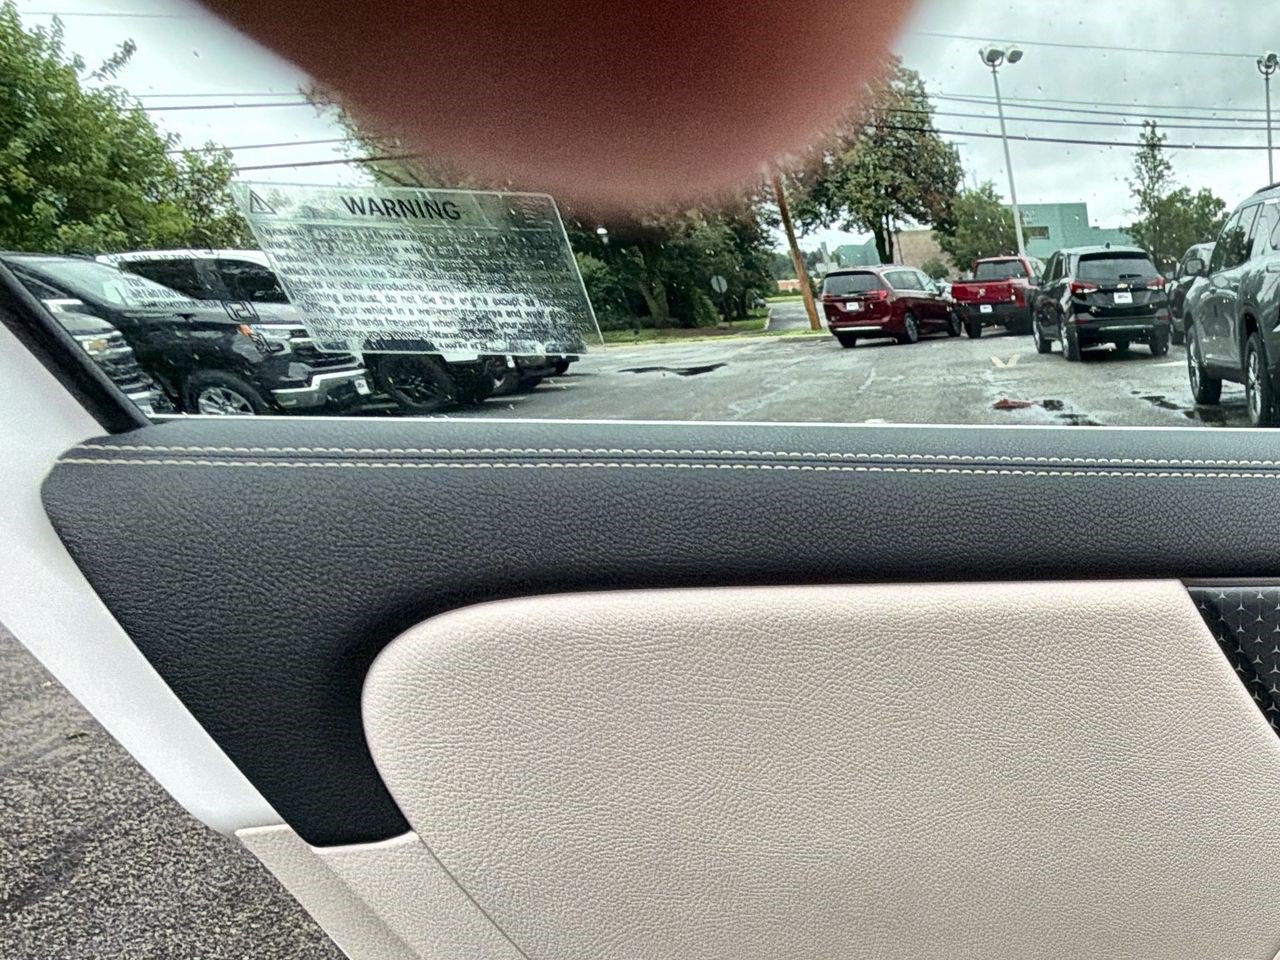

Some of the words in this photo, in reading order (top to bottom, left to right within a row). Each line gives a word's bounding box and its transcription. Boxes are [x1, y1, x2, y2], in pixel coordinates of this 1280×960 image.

[341, 195, 461, 220] WARNING
[365, 281, 425, 292] reproductive
[383, 294, 398, 302] do
[399, 295, 417, 303] not
[336, 306, 360, 316] your
[359, 306, 394, 314] vehicle
[394, 306, 406, 315] in
[354, 316, 385, 326] hands
[384, 317, 432, 328] frequently
